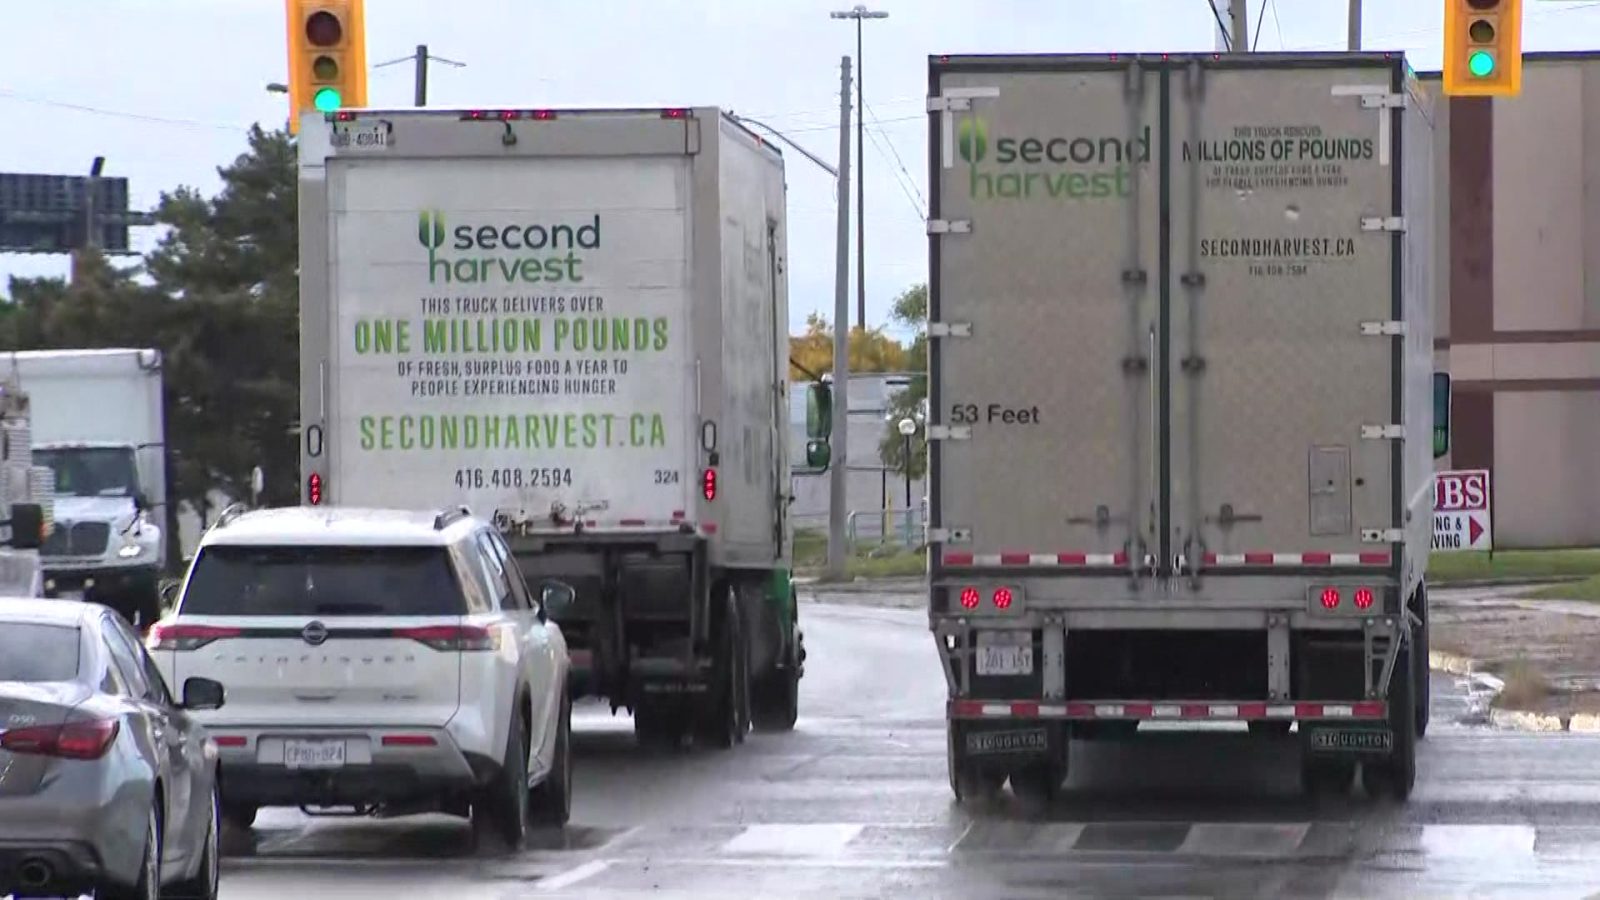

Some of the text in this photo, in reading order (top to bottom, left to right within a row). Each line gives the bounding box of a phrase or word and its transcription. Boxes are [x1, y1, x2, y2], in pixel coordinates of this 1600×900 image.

[996, 125, 1151, 163] second
[1271, 139, 1294, 160] OF
[1299, 138, 1373, 160] POUNDS
[970, 166, 1131, 198] harvest
[453, 213, 600, 250] second
[1200, 237, 1356, 257] SECONDHARVEST.CA
[428, 250, 583, 284] harvest
[421, 297, 604, 314] THIS TRUCK DELIVERS OVER
[354, 317, 669, 354] ONE MILLION POUNDS
[397, 359, 628, 377] OF FRESH, SURPLUS FOOD A YEAR TO
[411, 379, 617, 396] PEOPLE EXPERIENCING HUNGER
[951, 404, 1040, 424] 53 Feet
[360, 413, 666, 450] SECONDHARVEST.CA
[454, 467, 573, 488] 416.408.2594
[654, 469, 680, 484] 324
[1433, 476, 1484, 508] BS
[1430, 533, 1461, 549] VING
